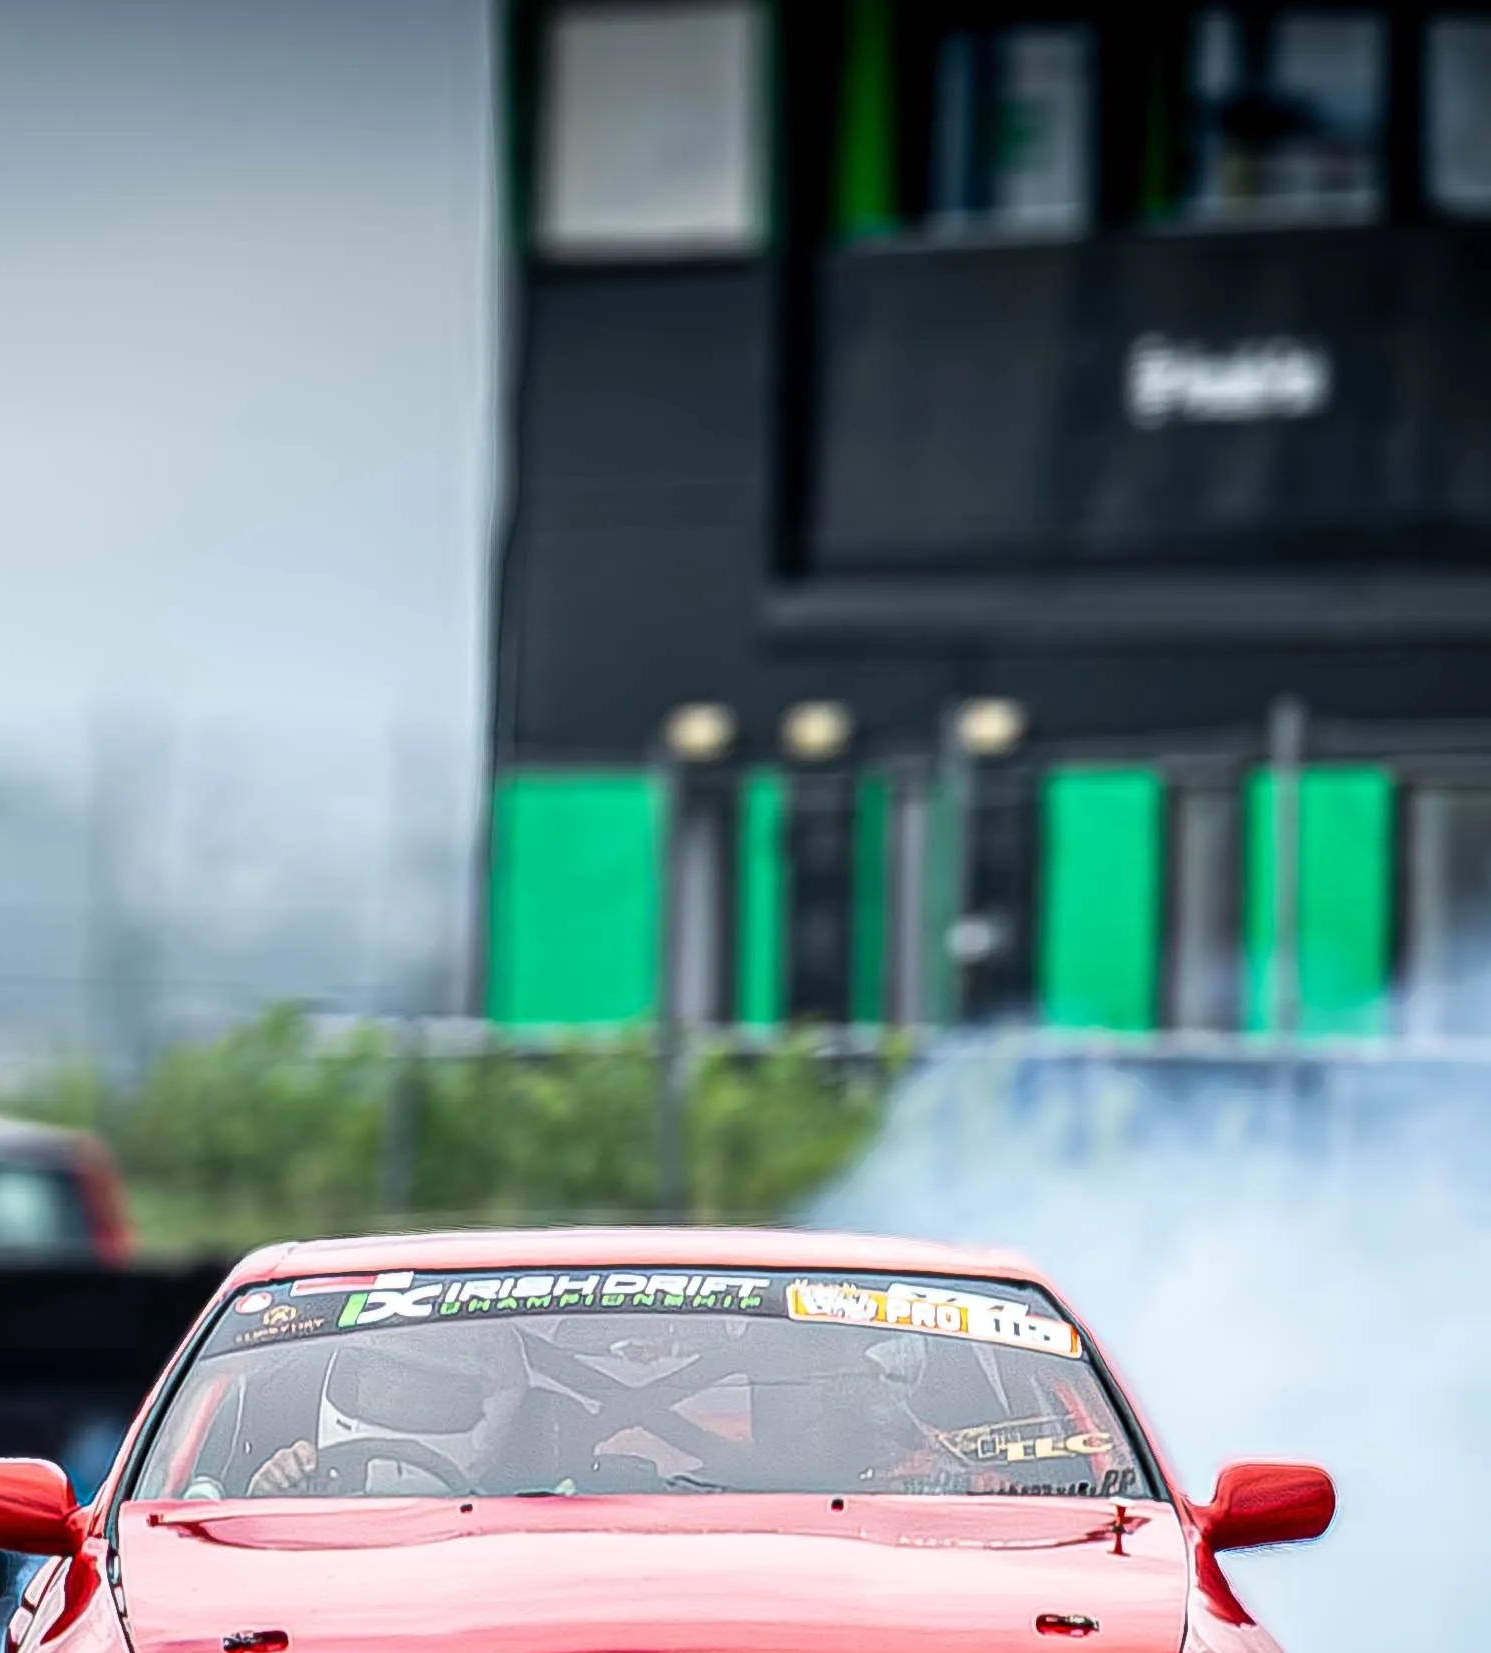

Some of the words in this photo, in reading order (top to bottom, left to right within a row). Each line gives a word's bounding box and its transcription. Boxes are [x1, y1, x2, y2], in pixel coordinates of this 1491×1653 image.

[444, 1275, 600, 1303] IRISH
[601, 1273, 770, 1299] DRIFT
[885, 1299, 961, 1333] PRO
